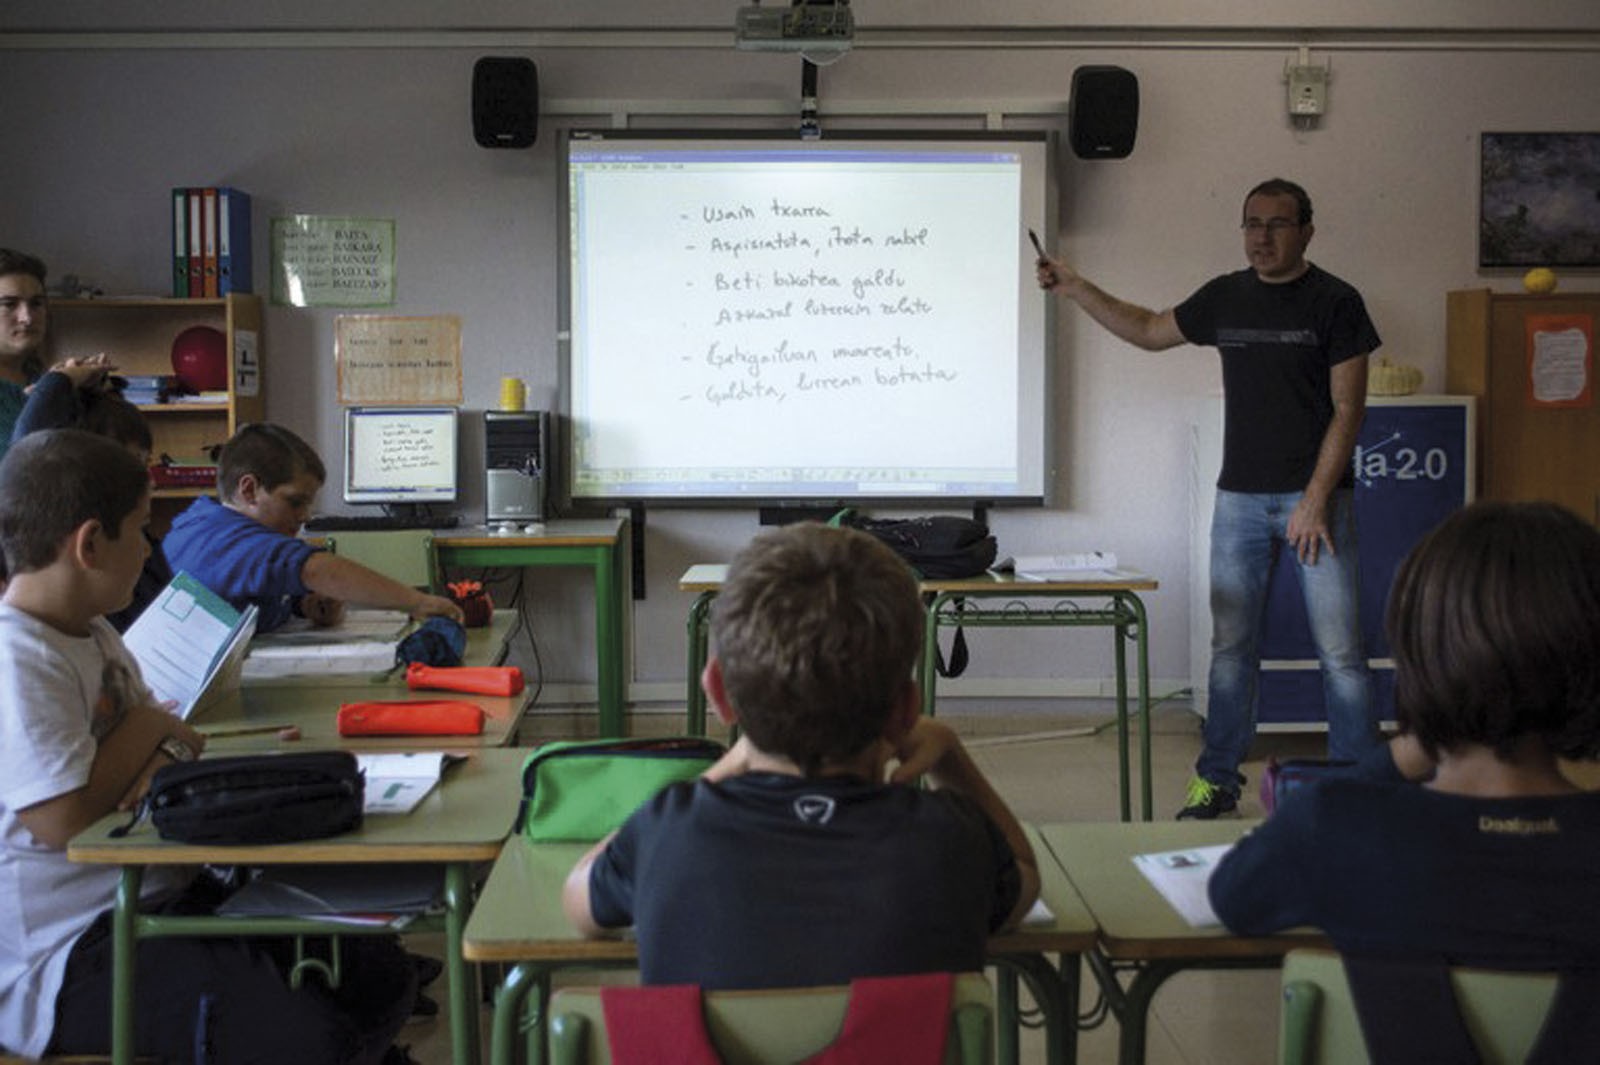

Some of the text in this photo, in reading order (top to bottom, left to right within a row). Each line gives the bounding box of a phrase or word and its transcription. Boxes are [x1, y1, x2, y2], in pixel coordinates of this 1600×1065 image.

[769, 197, 831, 218] txarra
[715, 271, 762, 292] Beti
[1352, 445, 1448, 481] la 2.0
